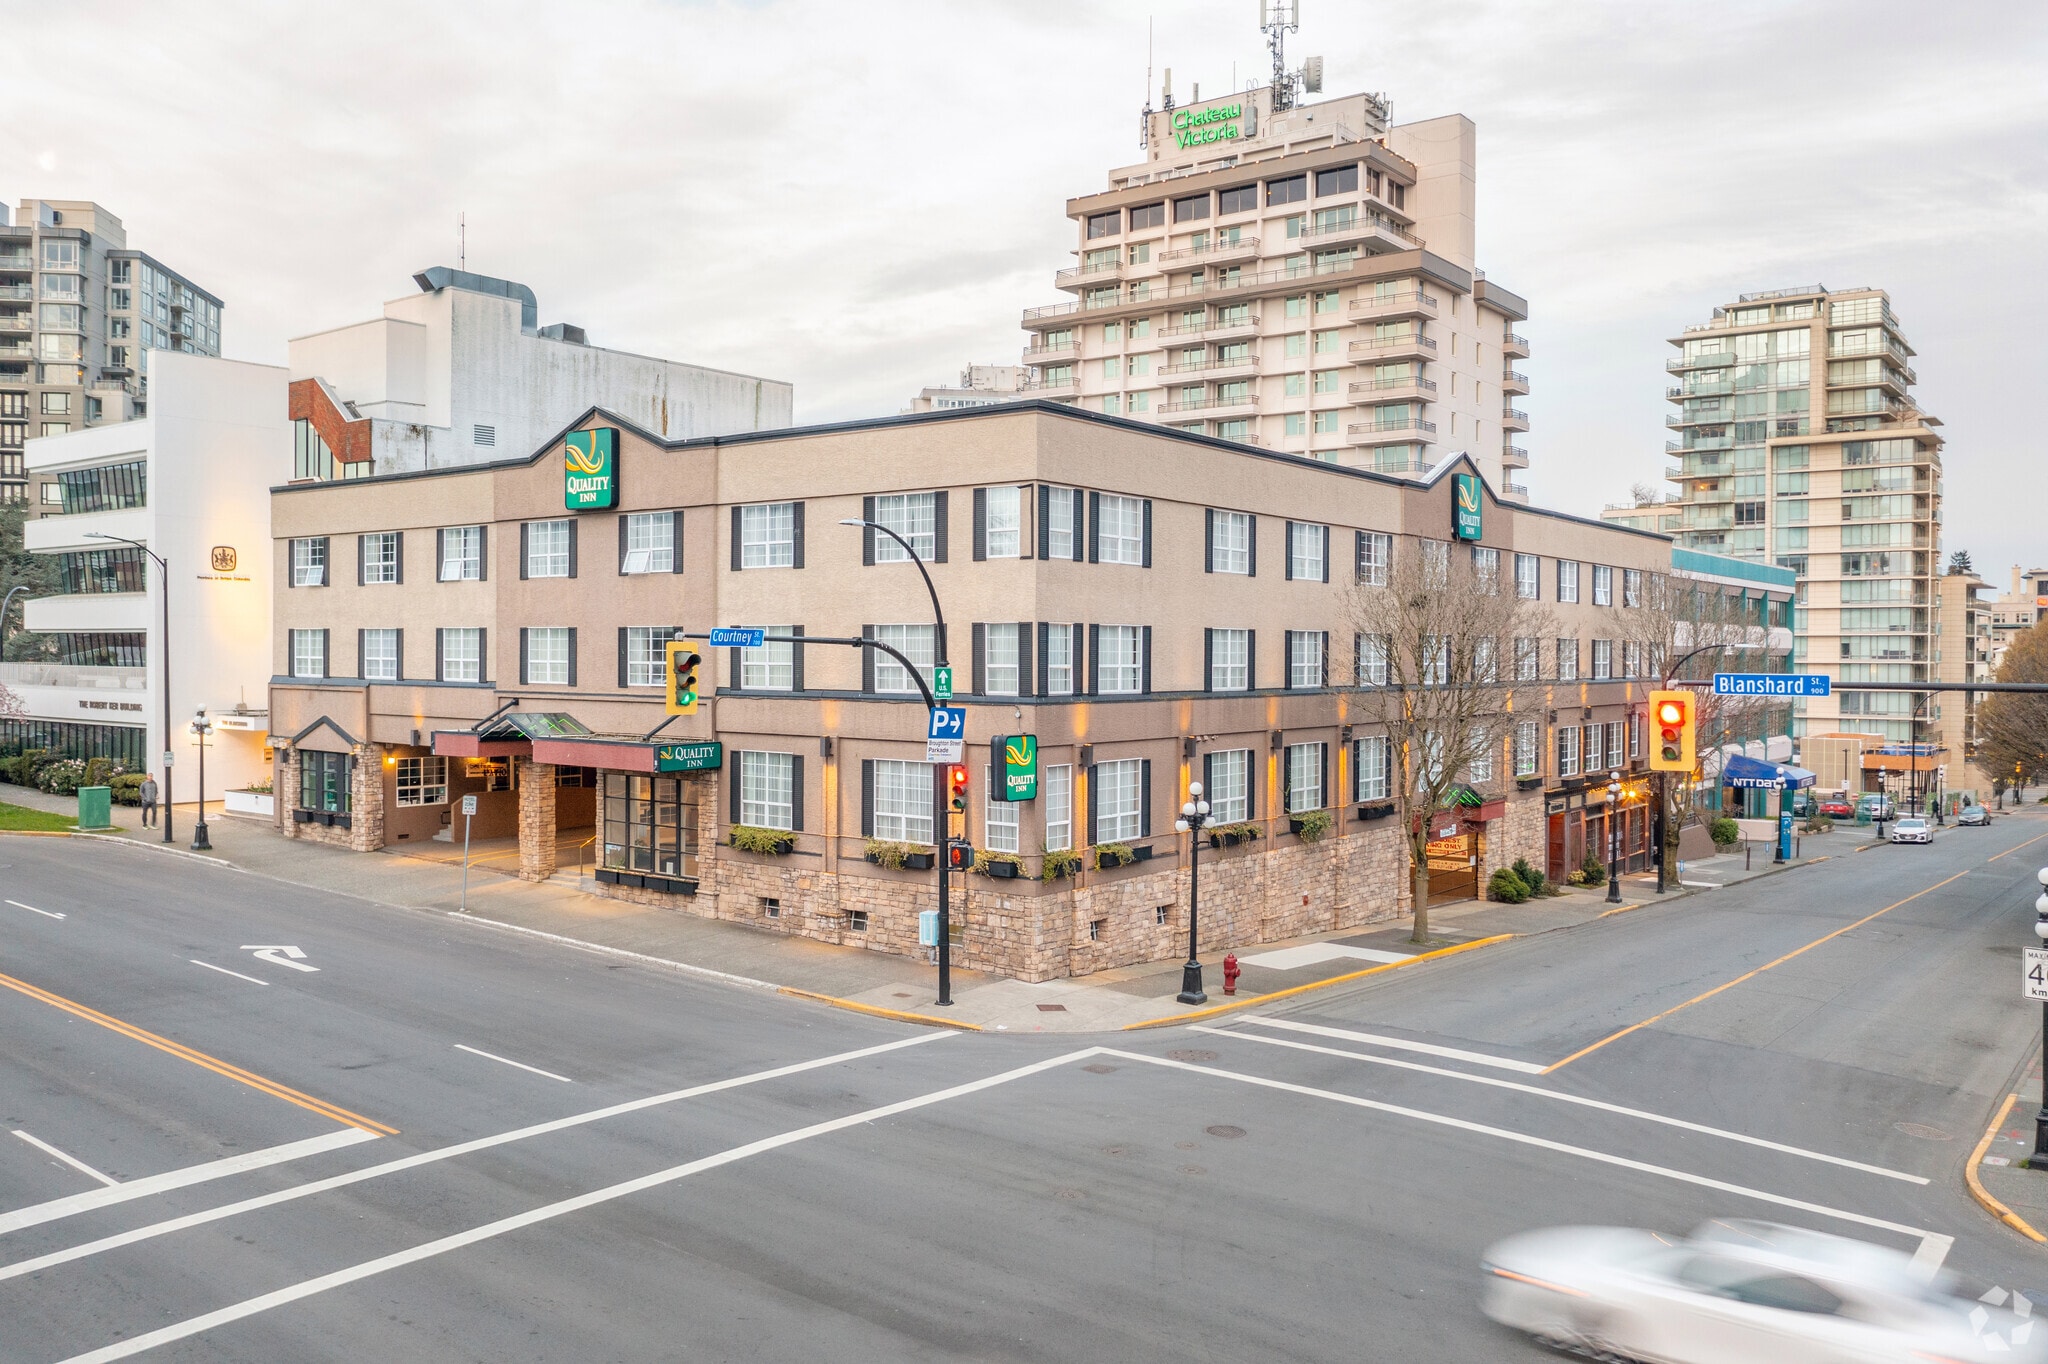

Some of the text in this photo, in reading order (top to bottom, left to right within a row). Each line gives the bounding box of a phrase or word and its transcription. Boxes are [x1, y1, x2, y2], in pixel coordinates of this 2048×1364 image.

[1172, 103, 1241, 129] Chateau
[1174, 122, 1239, 150] Victoria
[567, 476, 609, 494] QUALITY
[580, 492, 597, 502] INN
[1459, 511, 1481, 527] QUALITY
[1465, 526, 1475, 535] INN
[713, 630, 752, 645] Courtney
[1720, 676, 1804, 694] Blanshard
[79, 700, 88, 708] THE
[120, 703, 142, 712] BUILDING
[932, 710, 949, 736] P
[675, 747, 714, 760] QUALITY
[1007, 775, 1034, 787] QUALITY
[1734, 778, 1755, 786] NTT
